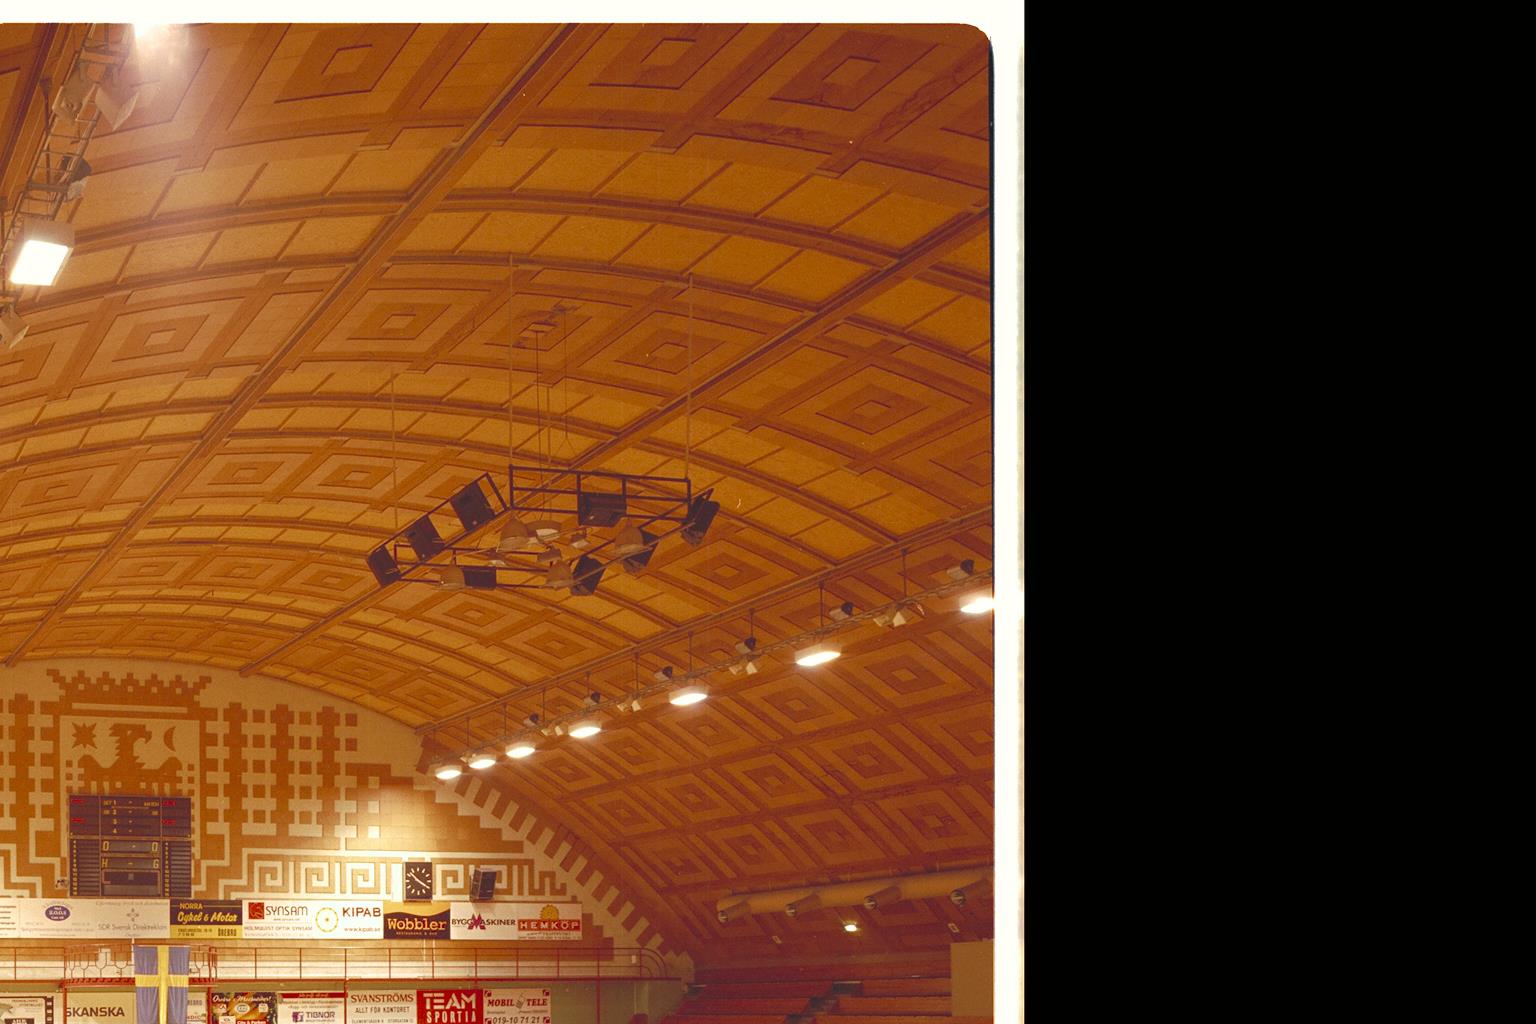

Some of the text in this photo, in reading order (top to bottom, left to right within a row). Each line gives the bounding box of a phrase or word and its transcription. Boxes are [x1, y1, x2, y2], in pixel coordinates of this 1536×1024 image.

[209, 911, 238, 923] Motor
[342, 907, 381, 918] KIPAB
[387, 917, 447, 931] Wobbler
[520, 919, 580, 930] HEMKÖP
[350, 992, 414, 1003] SVANSTRÖMS
[423, 992, 477, 1010] TEAM
[487, 998, 548, 1007] MOBIL TELE
[65, 1006, 126, 1018] SKANSKA
[426, 1010, 477, 1024] SPORTIA
